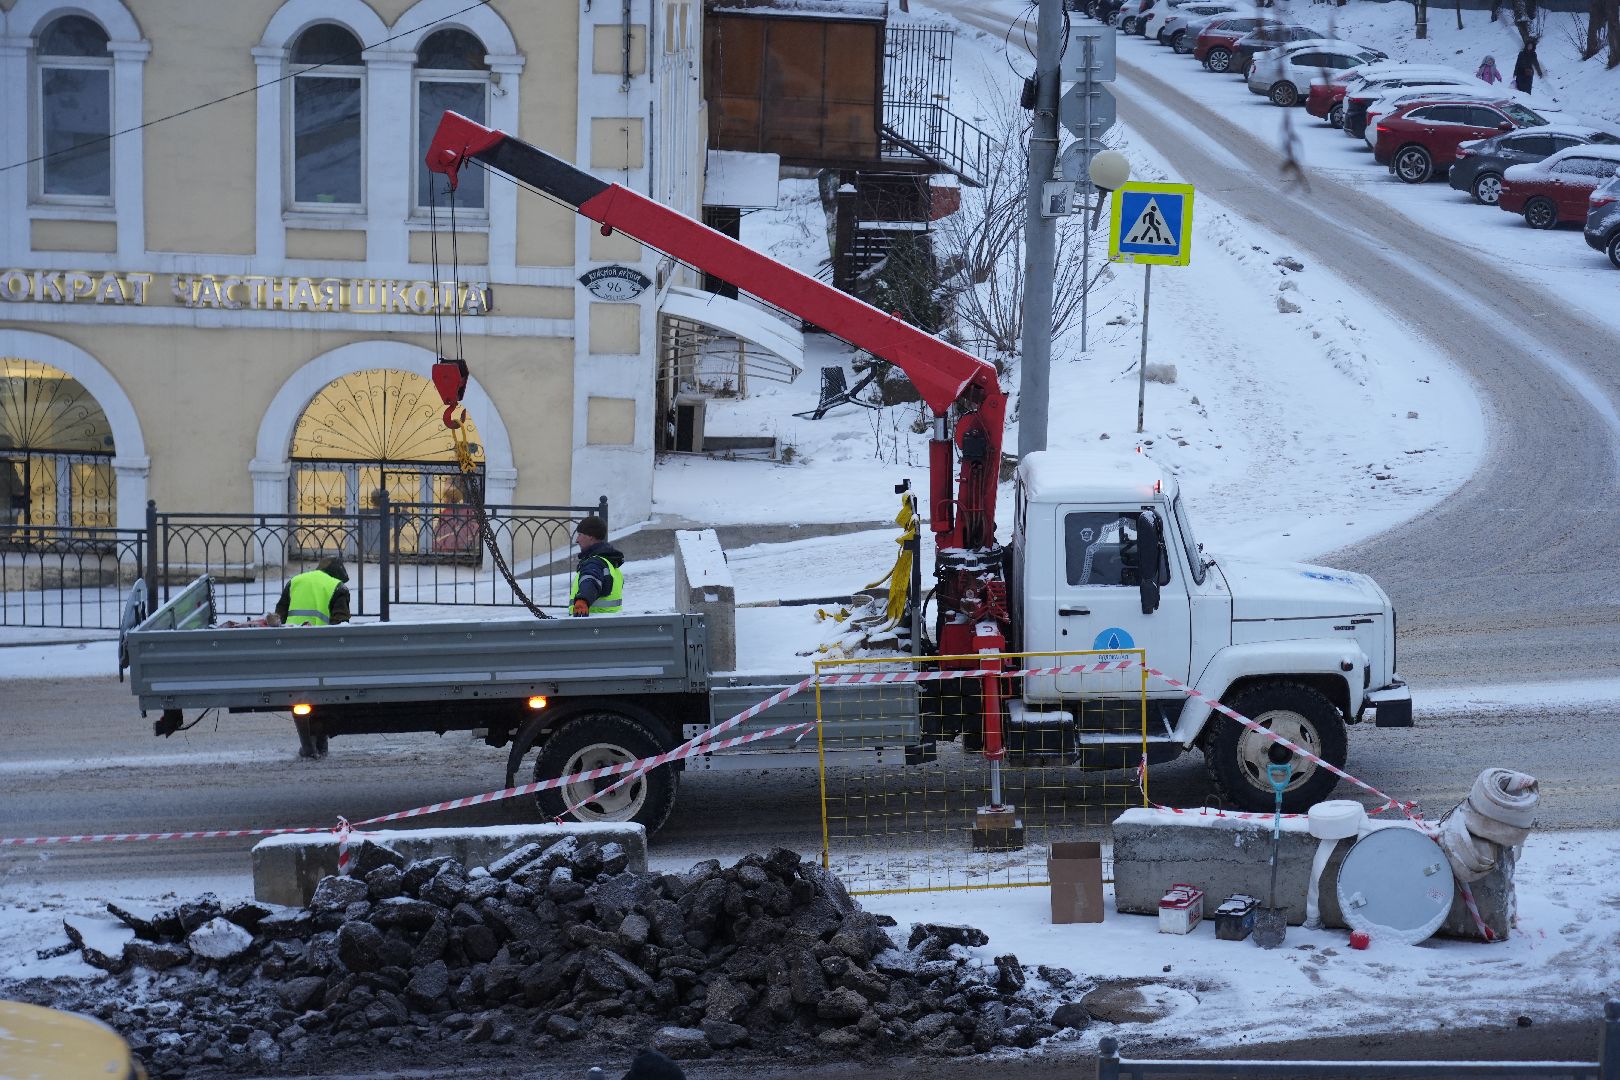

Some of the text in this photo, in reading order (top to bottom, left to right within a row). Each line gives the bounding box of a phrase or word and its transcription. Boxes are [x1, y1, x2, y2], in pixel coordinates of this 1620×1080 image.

[0, 270, 490, 316] ОКРАТ ЧАСТНАЯ ШКОЛА
[607, 281, 622, 293] 96
